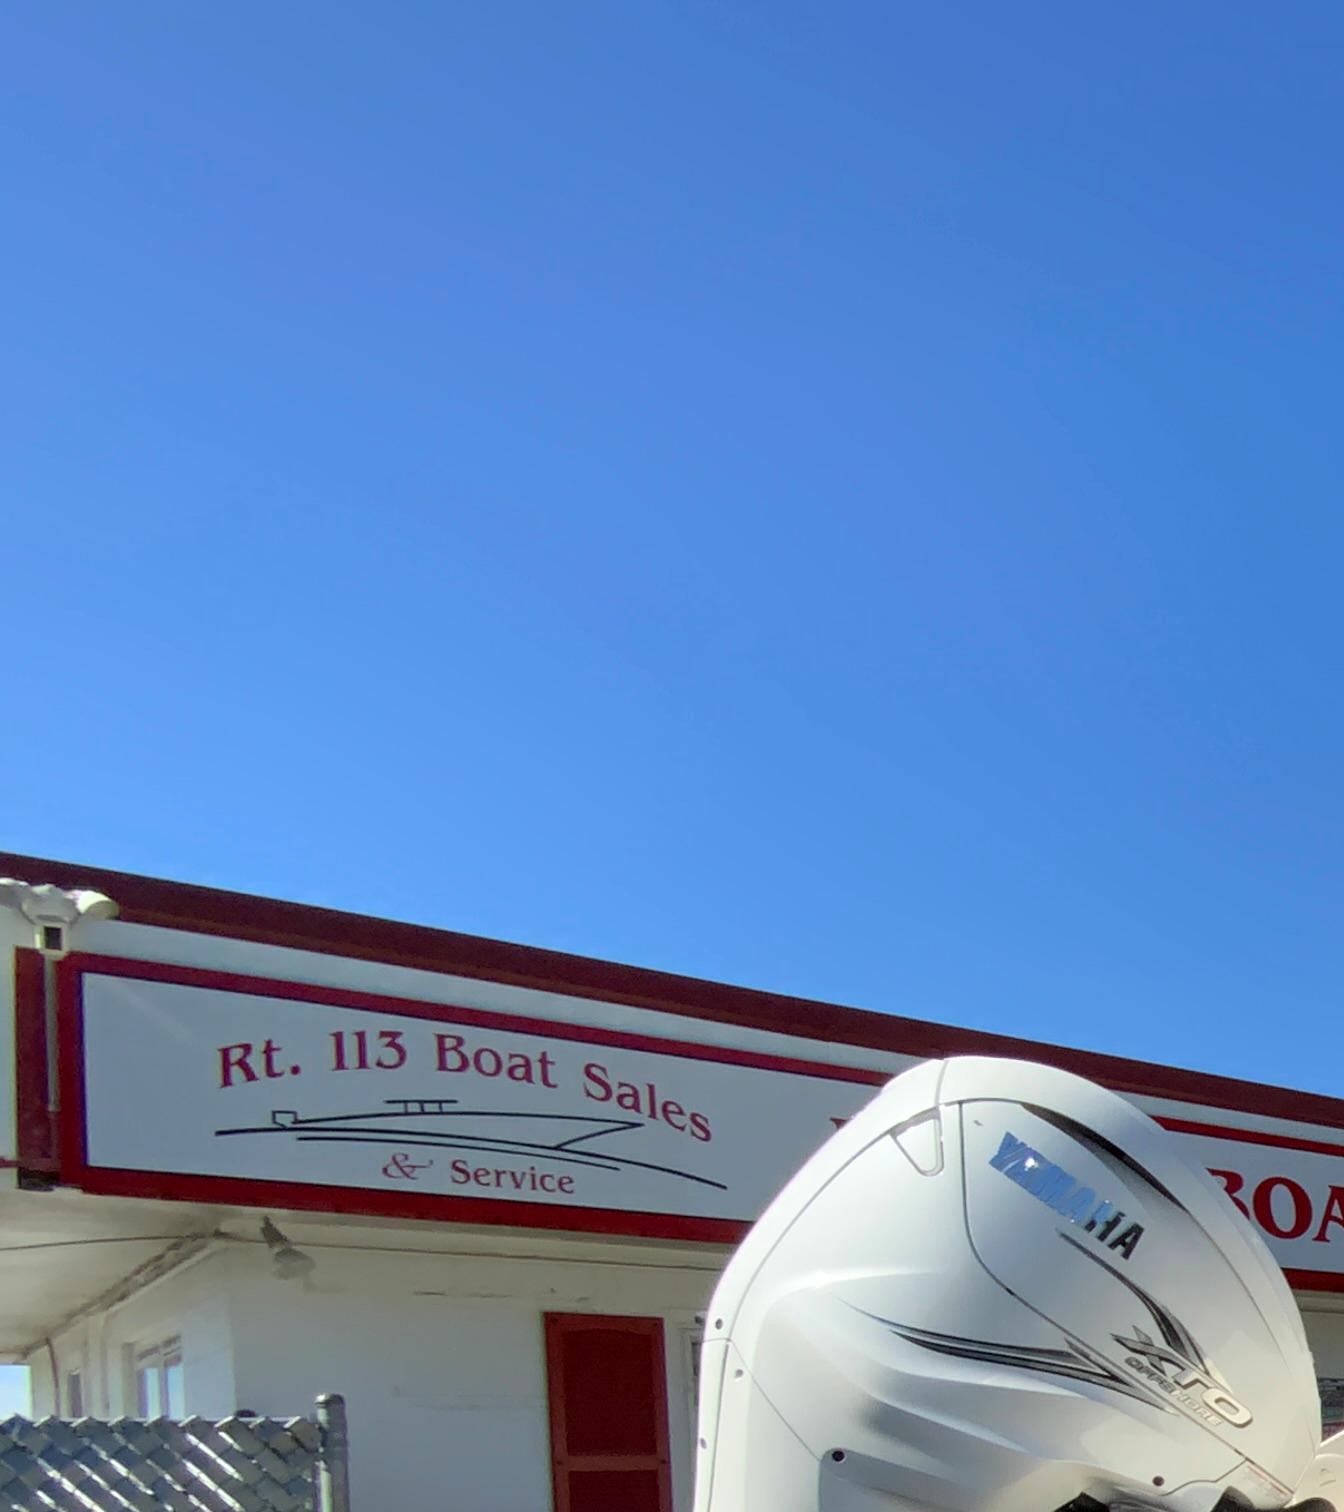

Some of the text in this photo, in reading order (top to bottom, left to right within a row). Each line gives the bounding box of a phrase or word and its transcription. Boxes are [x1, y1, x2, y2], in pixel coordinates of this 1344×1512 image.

[217, 1030, 712, 1142] Rt. 113 Boat Sales
[382, 1152, 575, 1194] & Service
[988, 1131, 1145, 1261] YAMAHA
[1110, 1325, 1253, 1428] XTO
[1124, 1356, 1222, 1427] OFFSHORE
